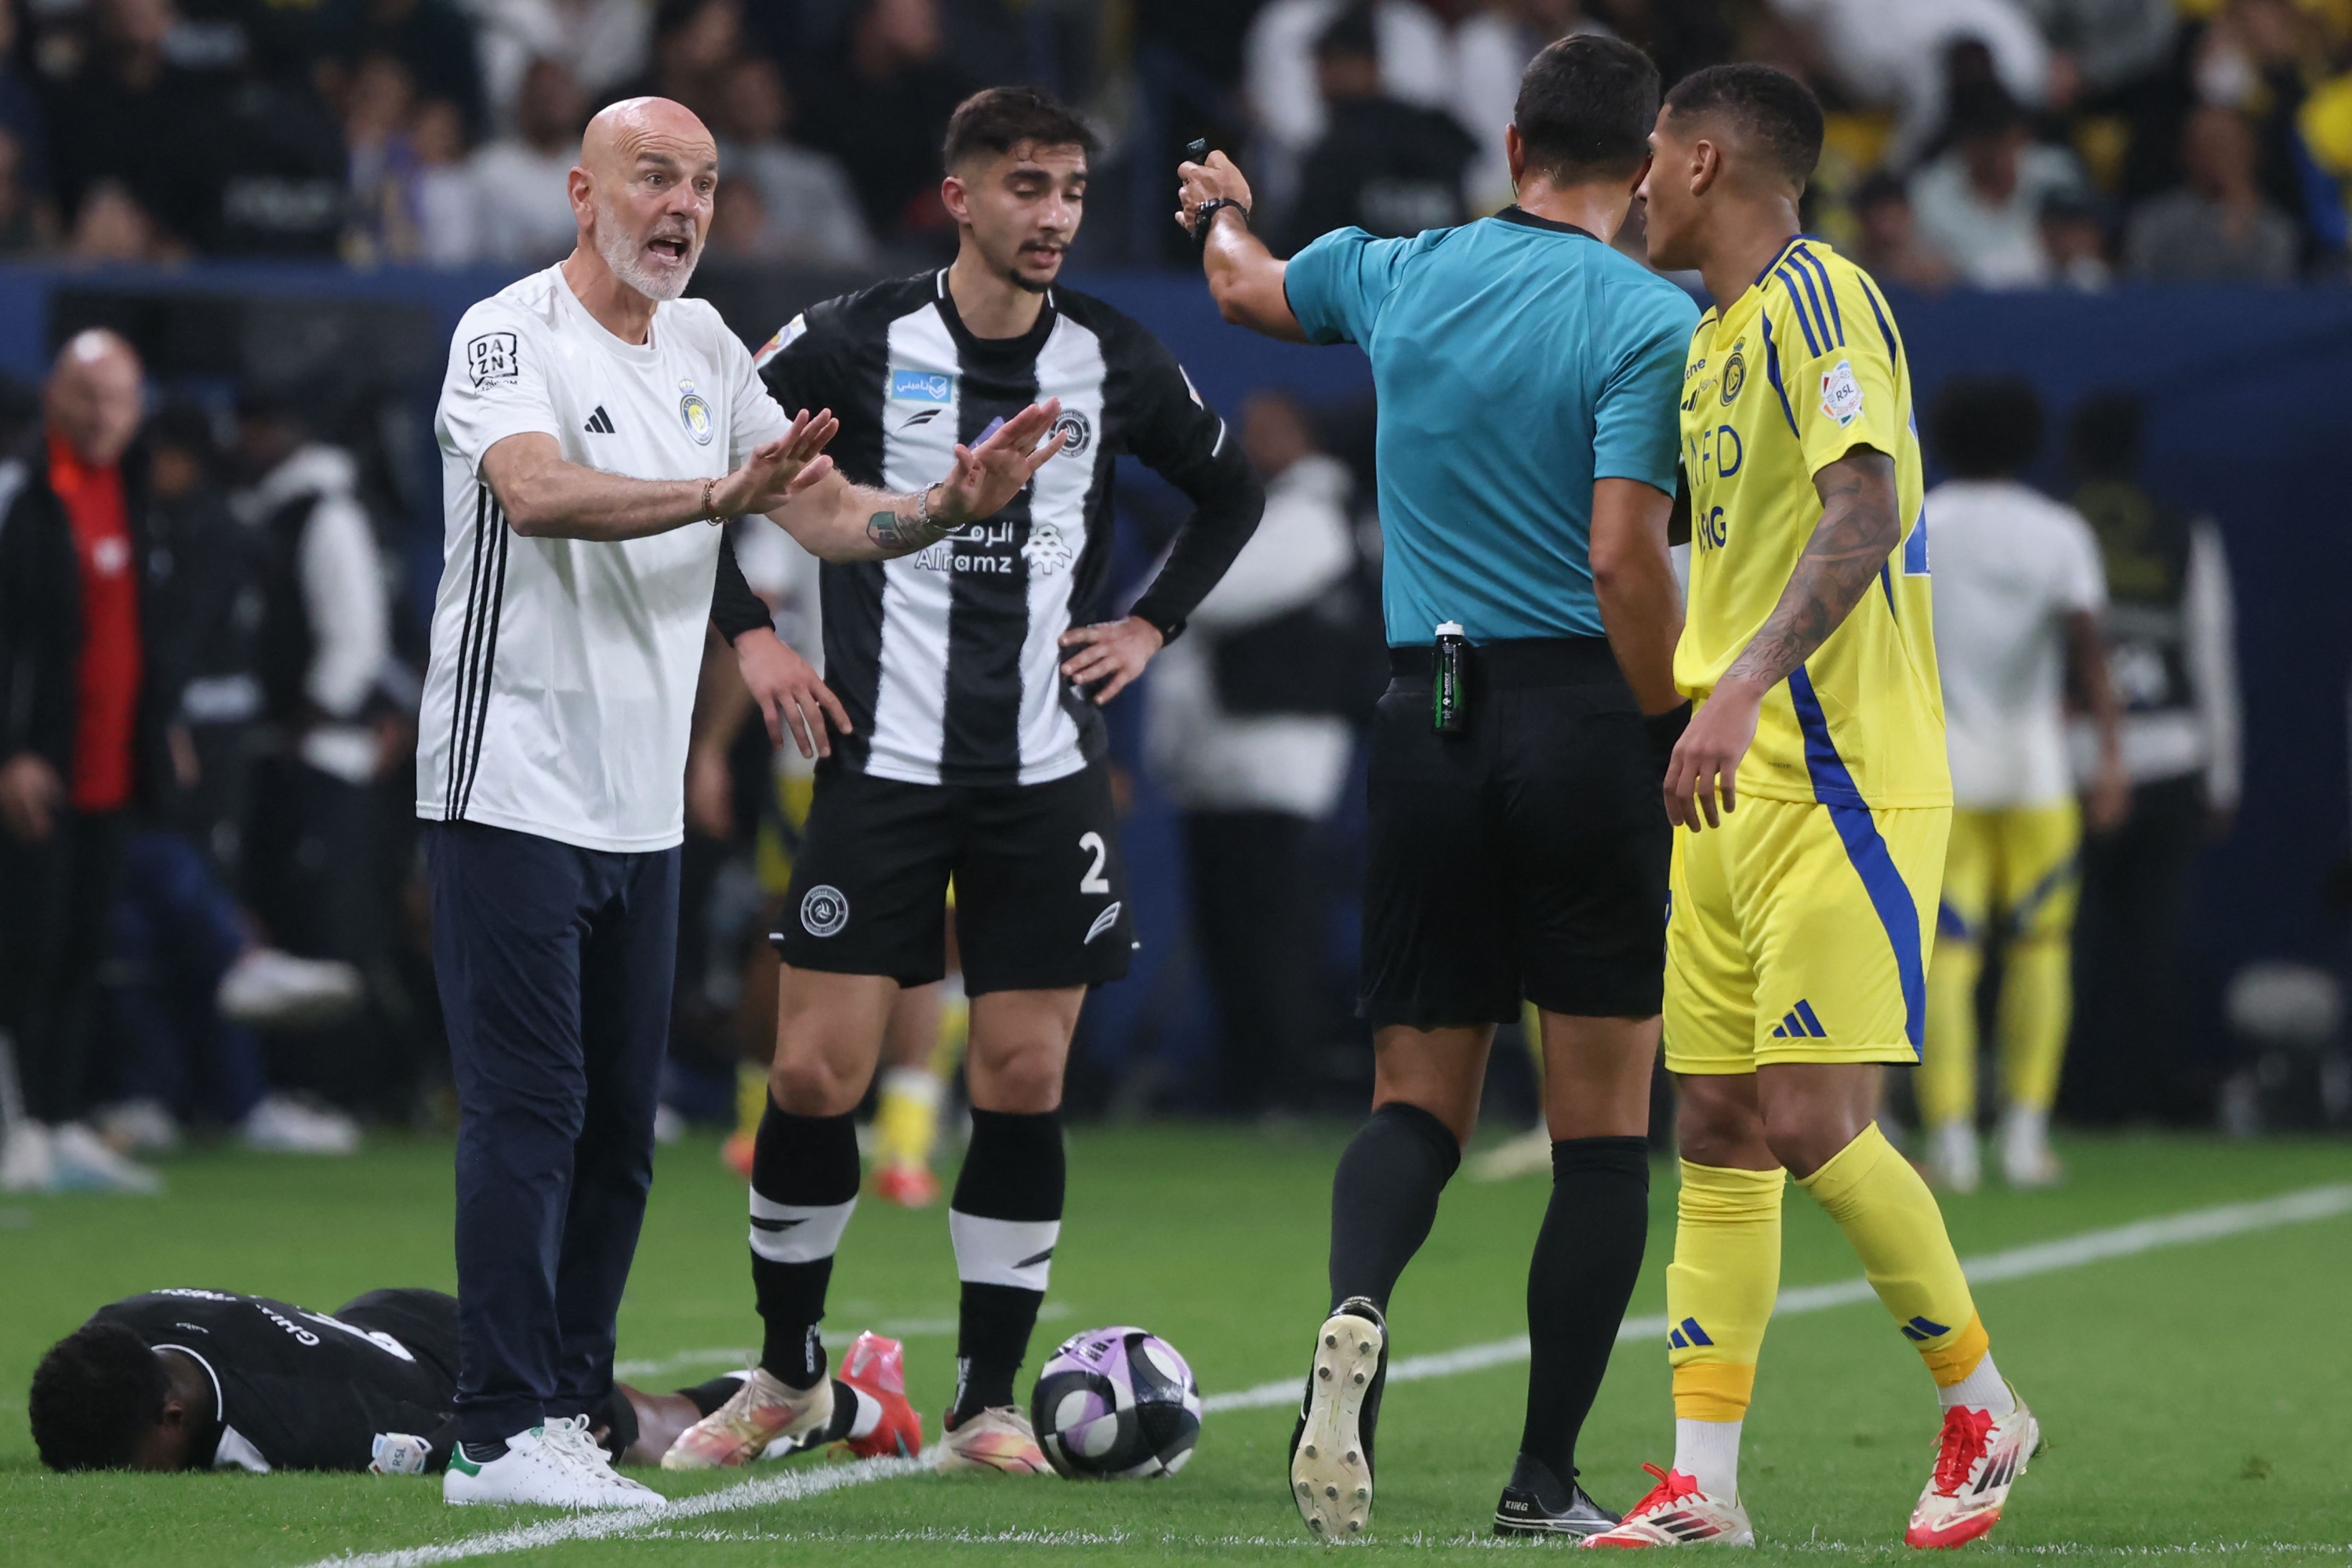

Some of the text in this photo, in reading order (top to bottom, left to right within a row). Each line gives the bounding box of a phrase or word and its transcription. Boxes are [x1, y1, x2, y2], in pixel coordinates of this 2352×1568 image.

[1835, 383, 1855, 402] RSL
[914, 547, 1012, 573] Alramz
[1078, 831, 1109, 894] 2
[392, 1446, 406, 1468] RSL
[1504, 1500, 1529, 1512] KING
